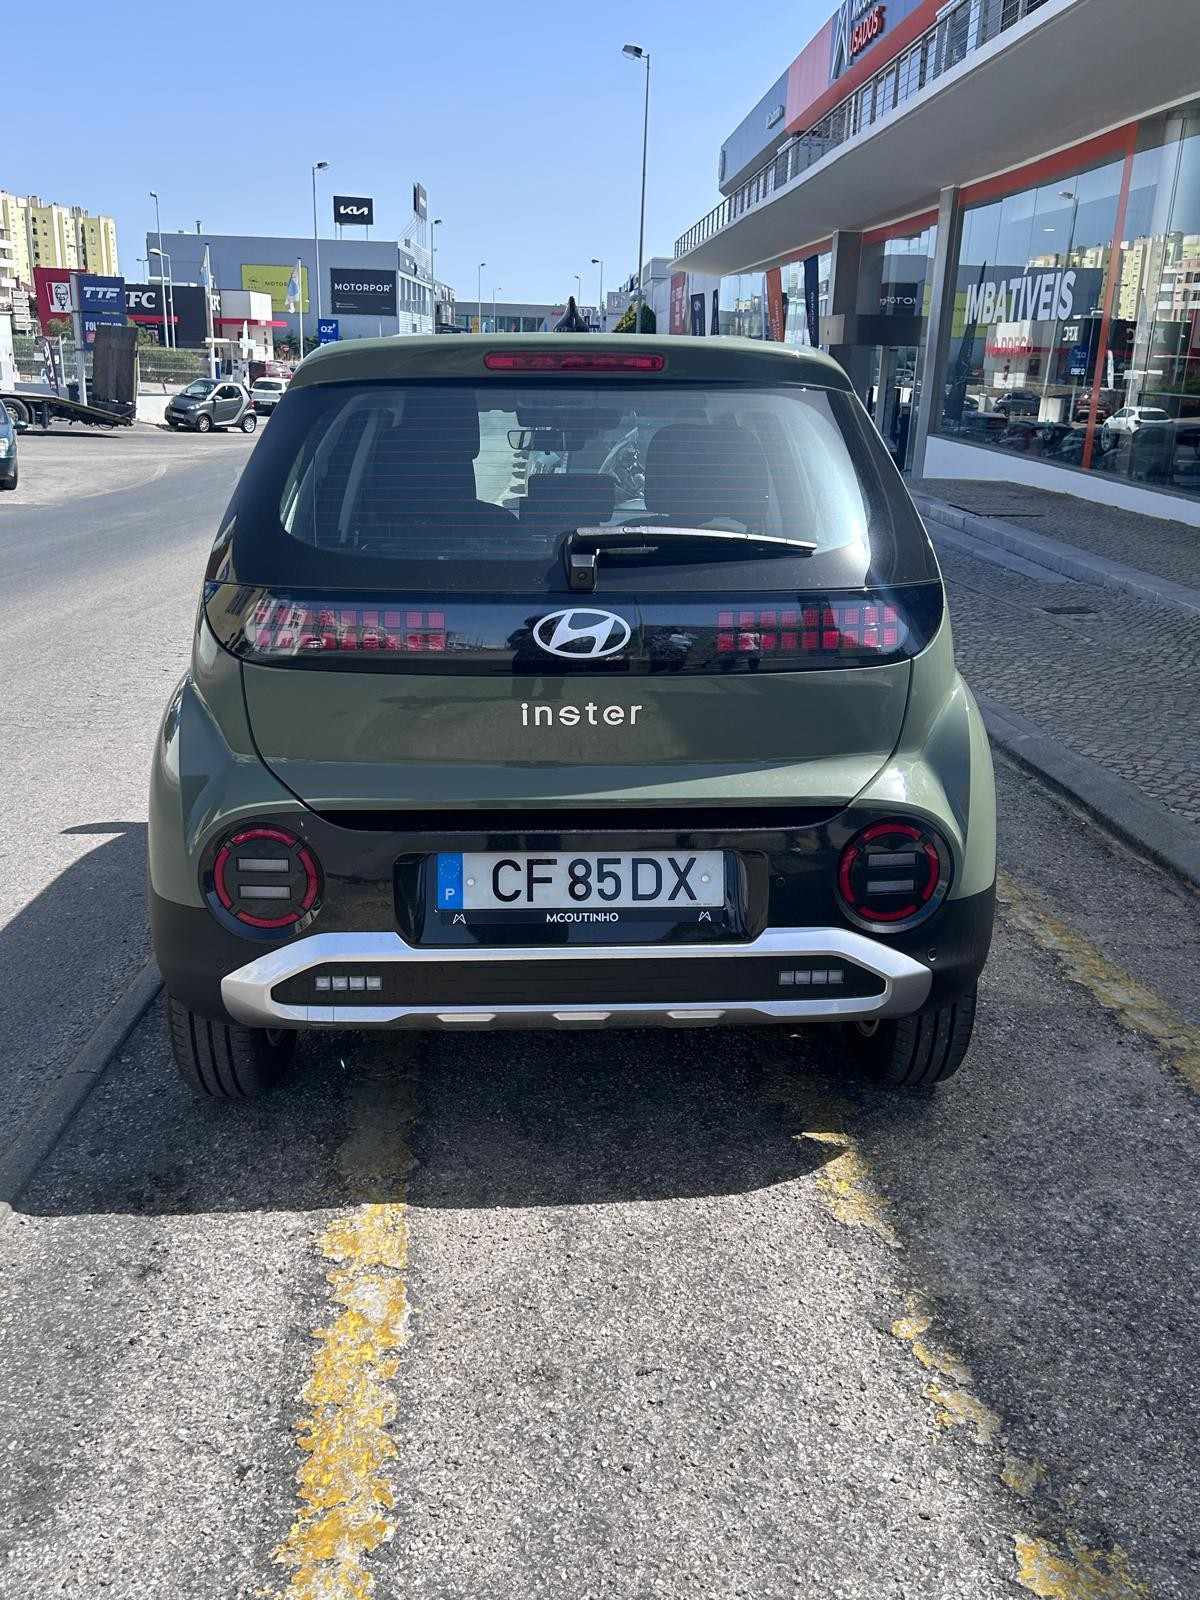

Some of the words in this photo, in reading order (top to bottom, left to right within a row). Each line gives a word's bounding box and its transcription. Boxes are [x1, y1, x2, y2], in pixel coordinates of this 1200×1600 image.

[83, 286, 120, 299] TTF
[334, 283, 392, 292] MOTORPOR
[125, 291, 156, 309] FC
[520, 702, 643, 726] inster
[492, 858, 558, 902] CF
[567, 857, 622, 901] 85
[631, 857, 698, 901] DX
[445, 888, 455, 900] P
[546, 912, 619, 923] MCOUTINHO
